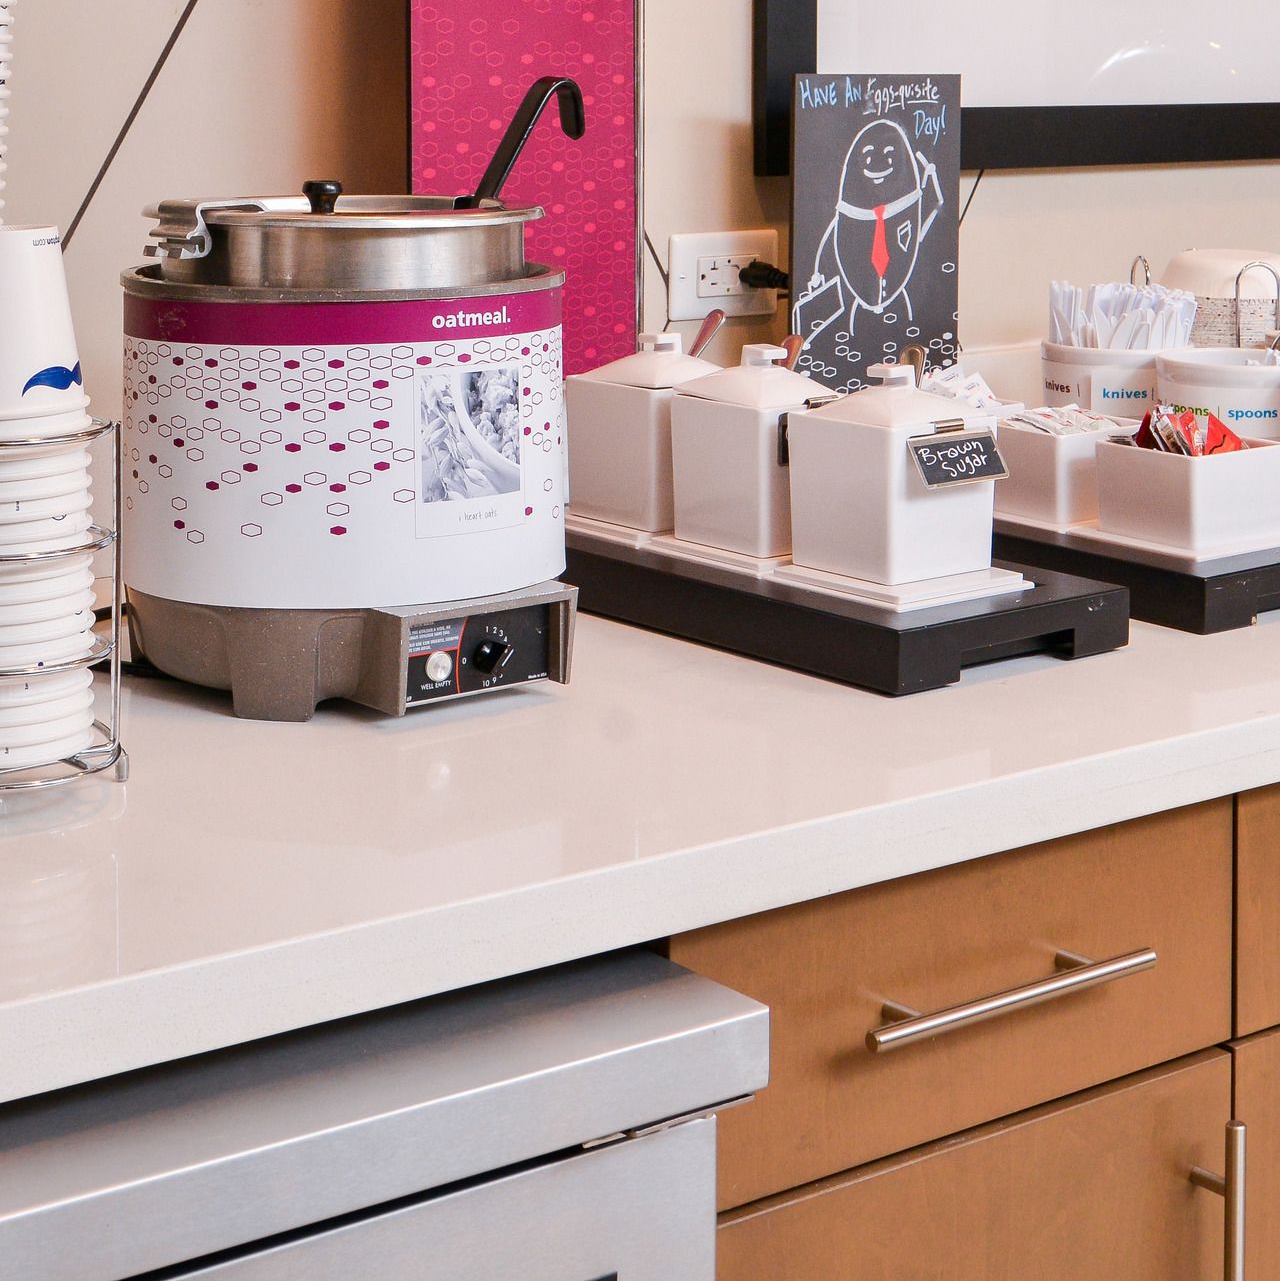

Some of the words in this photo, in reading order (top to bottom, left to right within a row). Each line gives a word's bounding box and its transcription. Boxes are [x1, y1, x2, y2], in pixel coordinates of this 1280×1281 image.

[799, 78, 838, 109] HAVE
[845, 76, 863, 108] AN
[912, 104, 947, 146] Day!
[431, 305, 511, 329] oatmeal.
[1102, 387, 1148, 400] knives
[1170, 403, 1209, 417] poons
[1227, 408, 1278, 420] spoons
[918, 441, 984, 466] Brown
[941, 454, 988, 478] Sugar
[492, 626, 498, 634] 2
[499, 629, 504, 637] 3
[461, 657, 467, 665] 0
[420, 683, 434, 691] WELL
[434, 679, 452, 690] EMPTY
[482, 679, 490, 688] 10
[492, 677, 497, 685] 9
